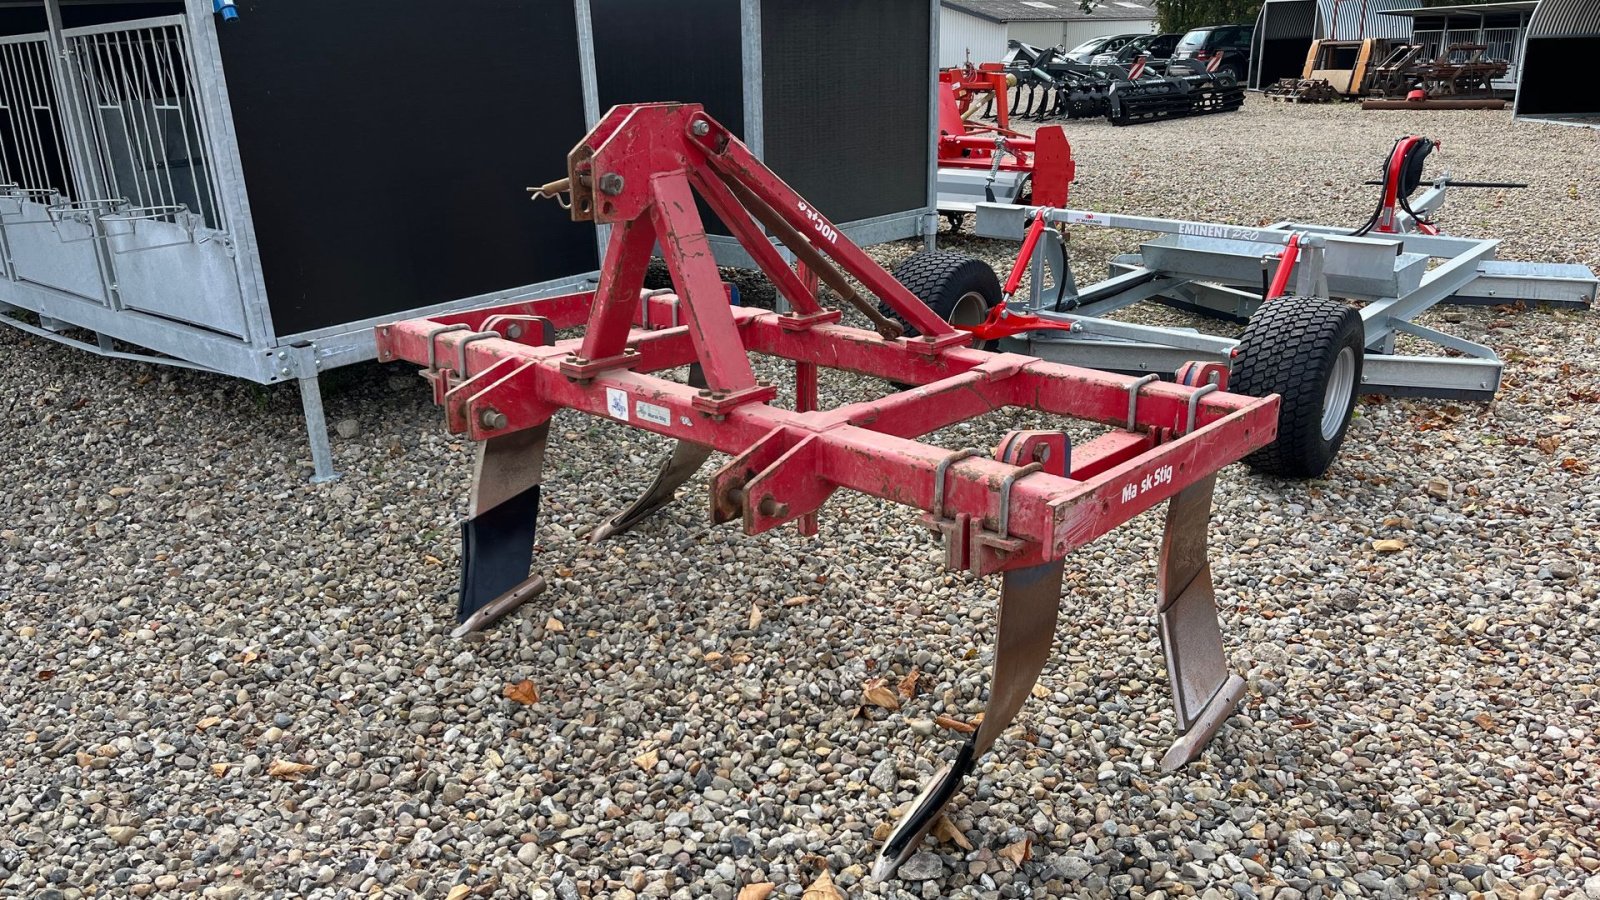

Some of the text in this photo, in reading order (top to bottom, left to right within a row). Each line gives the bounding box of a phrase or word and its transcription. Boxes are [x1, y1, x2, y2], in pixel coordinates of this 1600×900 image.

[1178, 222, 1260, 241] EMINENT PRO
[1153, 464, 1173, 487] Stig
